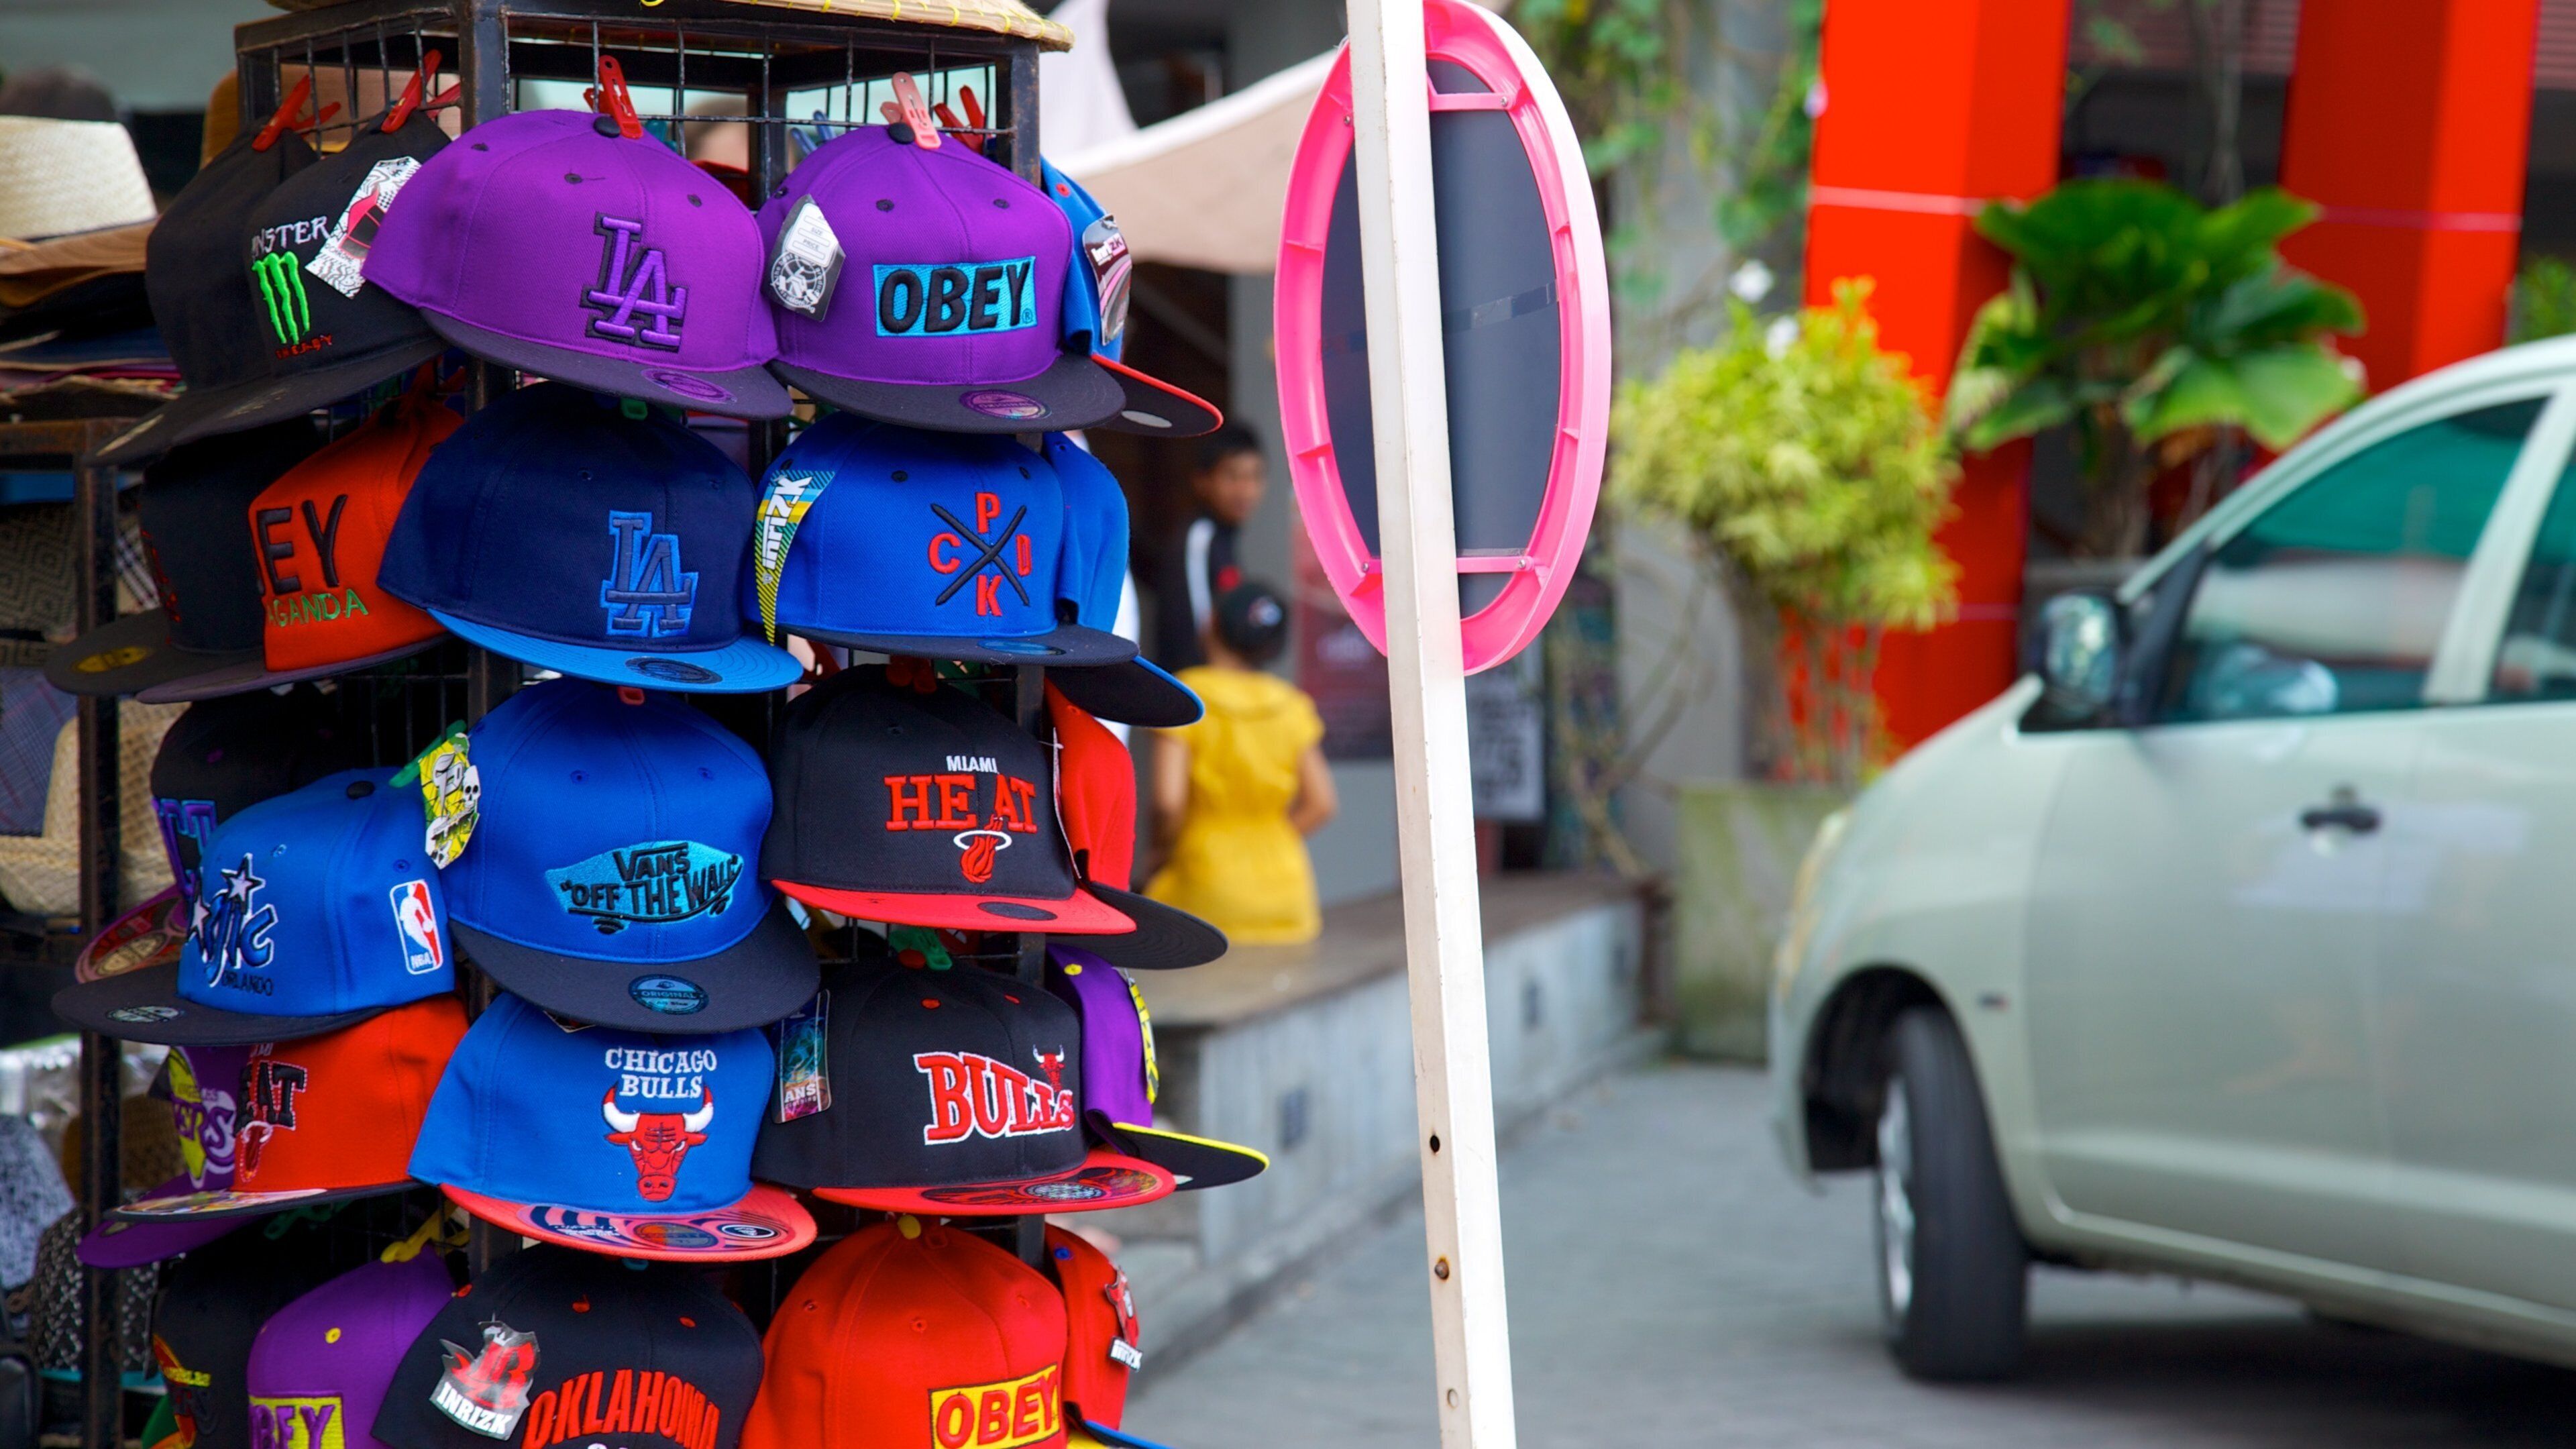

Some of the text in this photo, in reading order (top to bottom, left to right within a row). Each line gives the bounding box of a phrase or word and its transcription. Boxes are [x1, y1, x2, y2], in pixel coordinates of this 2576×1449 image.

[580, 211, 688, 354] LA
[879, 261, 1031, 334] OBEY
[975, 492, 1001, 534] P
[256, 494, 347, 596] EY
[601, 510, 699, 639] LA
[946, 755, 999, 773] MIAMI
[884, 773, 1038, 834] HEAT
[612, 843, 691, 881] VANS
[625, 875, 682, 915] THE
[221, 970, 274, 996] ORLANDO
[410, 952, 433, 969] NBA
[605, 1046, 717, 1074] CHICAGO
[619, 1074, 703, 1099] BULLS
[913, 1051, 1075, 1145] BULLS
[437, 1381, 513, 1435] INRIZK
[521, 1368, 720, 1449] OKLAHOMA
[936, 1371, 1057, 1448] OBEY
